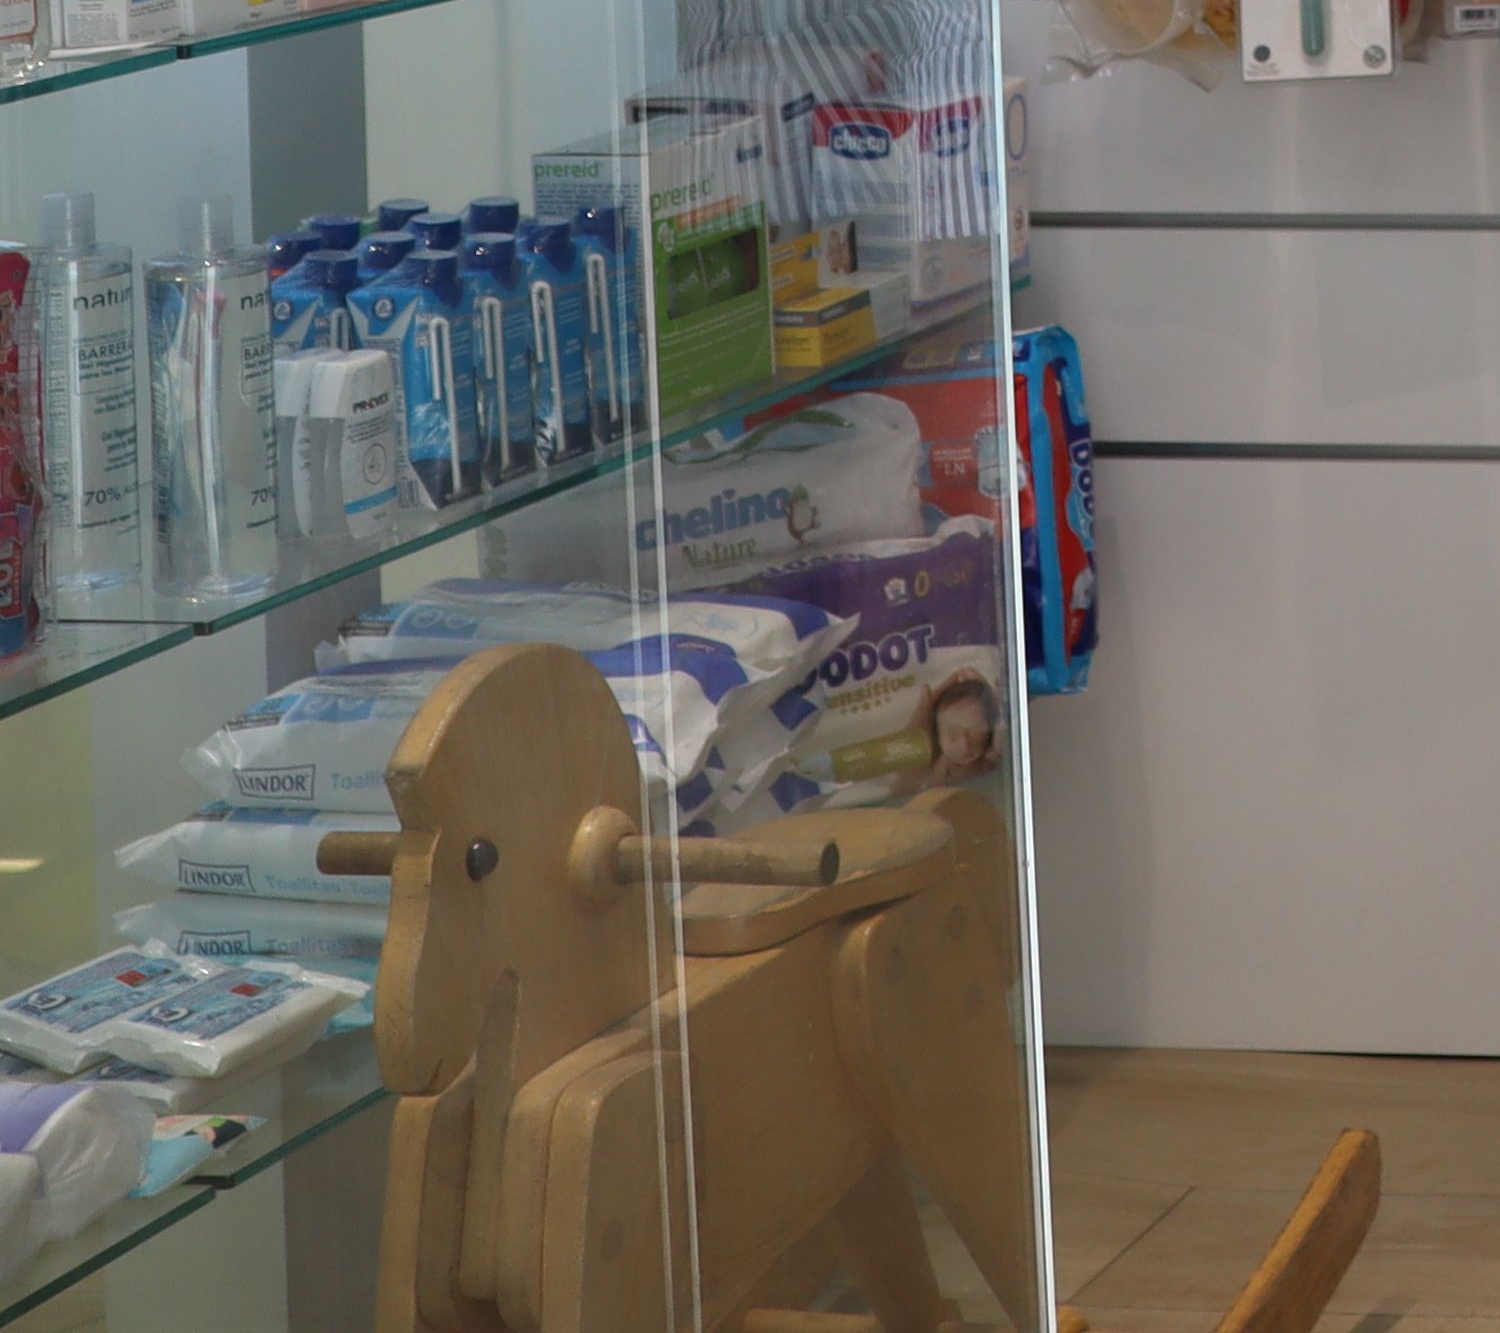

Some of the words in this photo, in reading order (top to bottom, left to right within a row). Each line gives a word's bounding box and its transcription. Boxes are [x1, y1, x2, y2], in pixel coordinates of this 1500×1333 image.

[84, 486, 122, 507] 70%
[635, 485, 788, 552] chelino
[802, 625, 936, 696] ODOT
